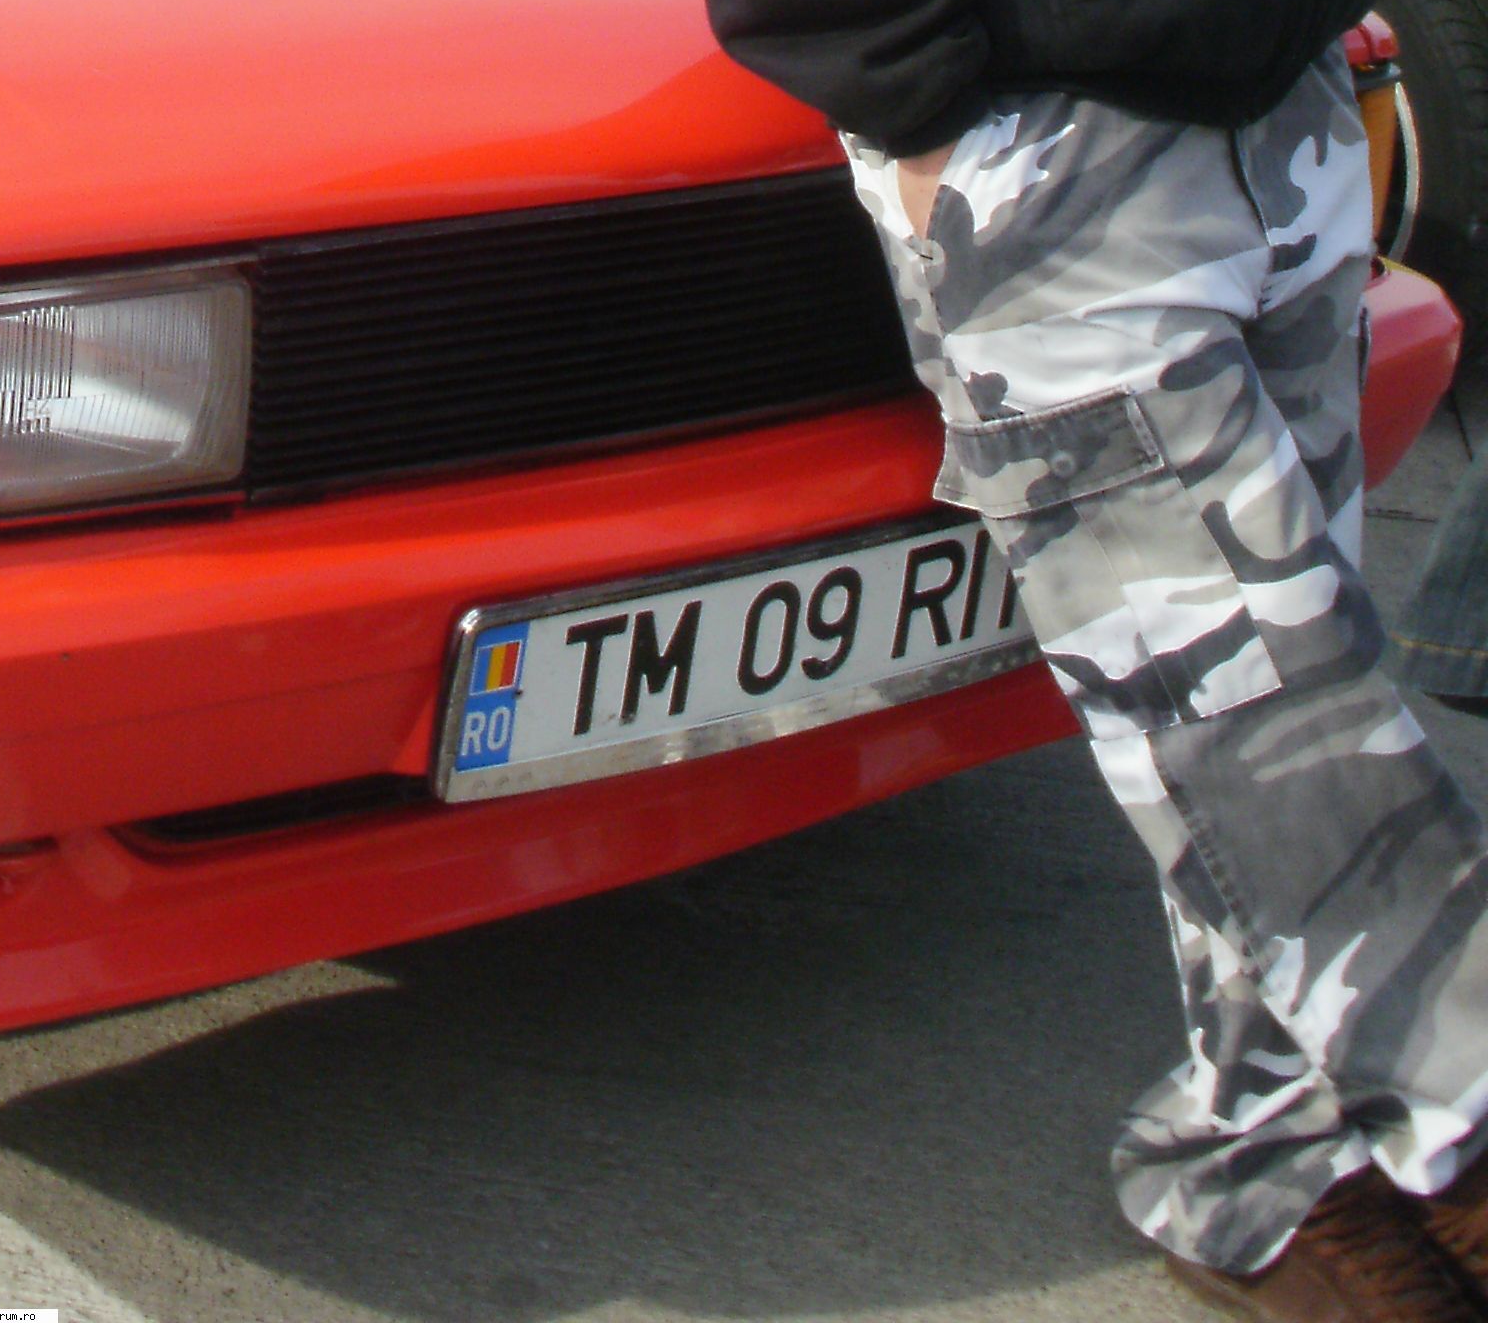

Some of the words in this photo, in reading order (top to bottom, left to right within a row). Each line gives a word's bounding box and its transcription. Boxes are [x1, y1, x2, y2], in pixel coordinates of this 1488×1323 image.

[565, 600, 702, 735] TM
[736, 565, 863, 696] 09
[459, 707, 511, 757] RO
